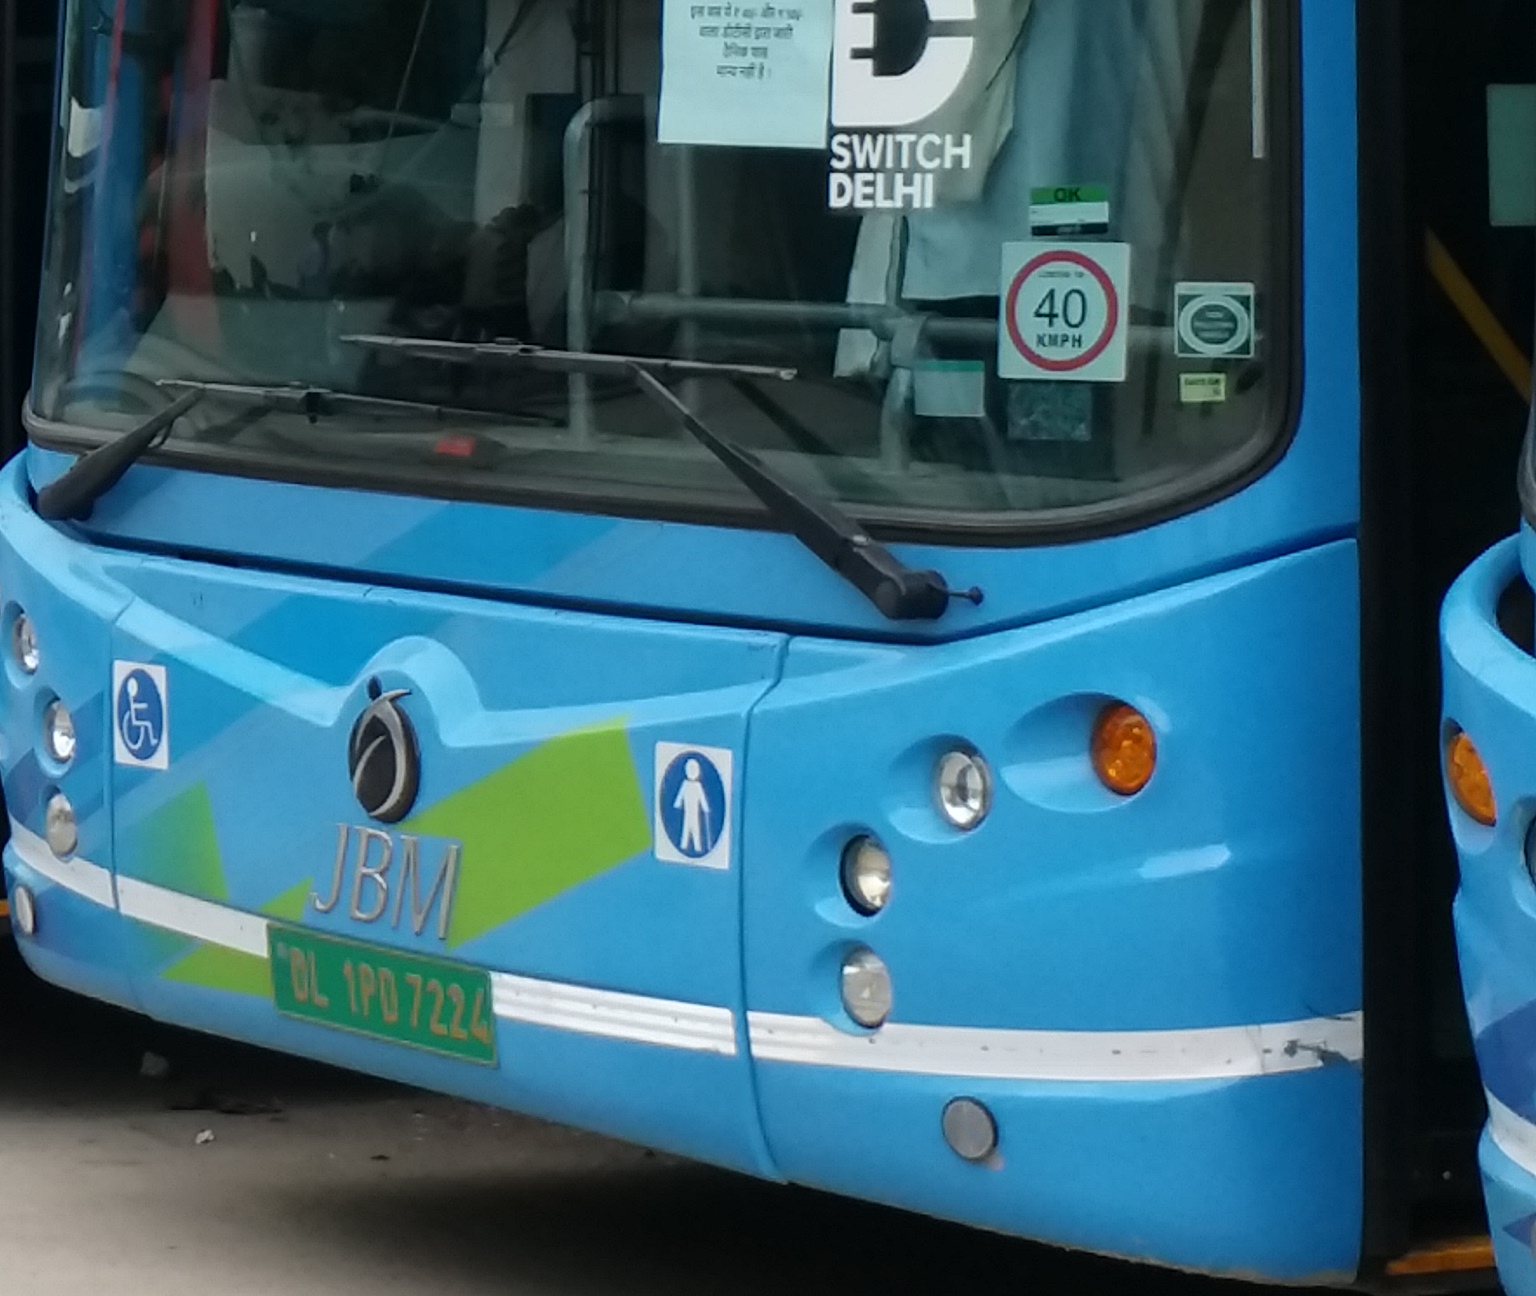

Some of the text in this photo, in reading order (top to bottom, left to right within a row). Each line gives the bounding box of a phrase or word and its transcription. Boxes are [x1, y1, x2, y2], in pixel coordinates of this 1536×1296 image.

[829, 132, 971, 170] SWITCH
[828, 172, 935, 209] DELHI
[1054, 187, 1082, 202] OK
[1033, 288, 1087, 329] 40
[1036, 333, 1083, 349] KMPH
[308, 822, 461, 941] JBM
[290, 947, 328, 1009] DL
[406, 972, 491, 1045] 7224
